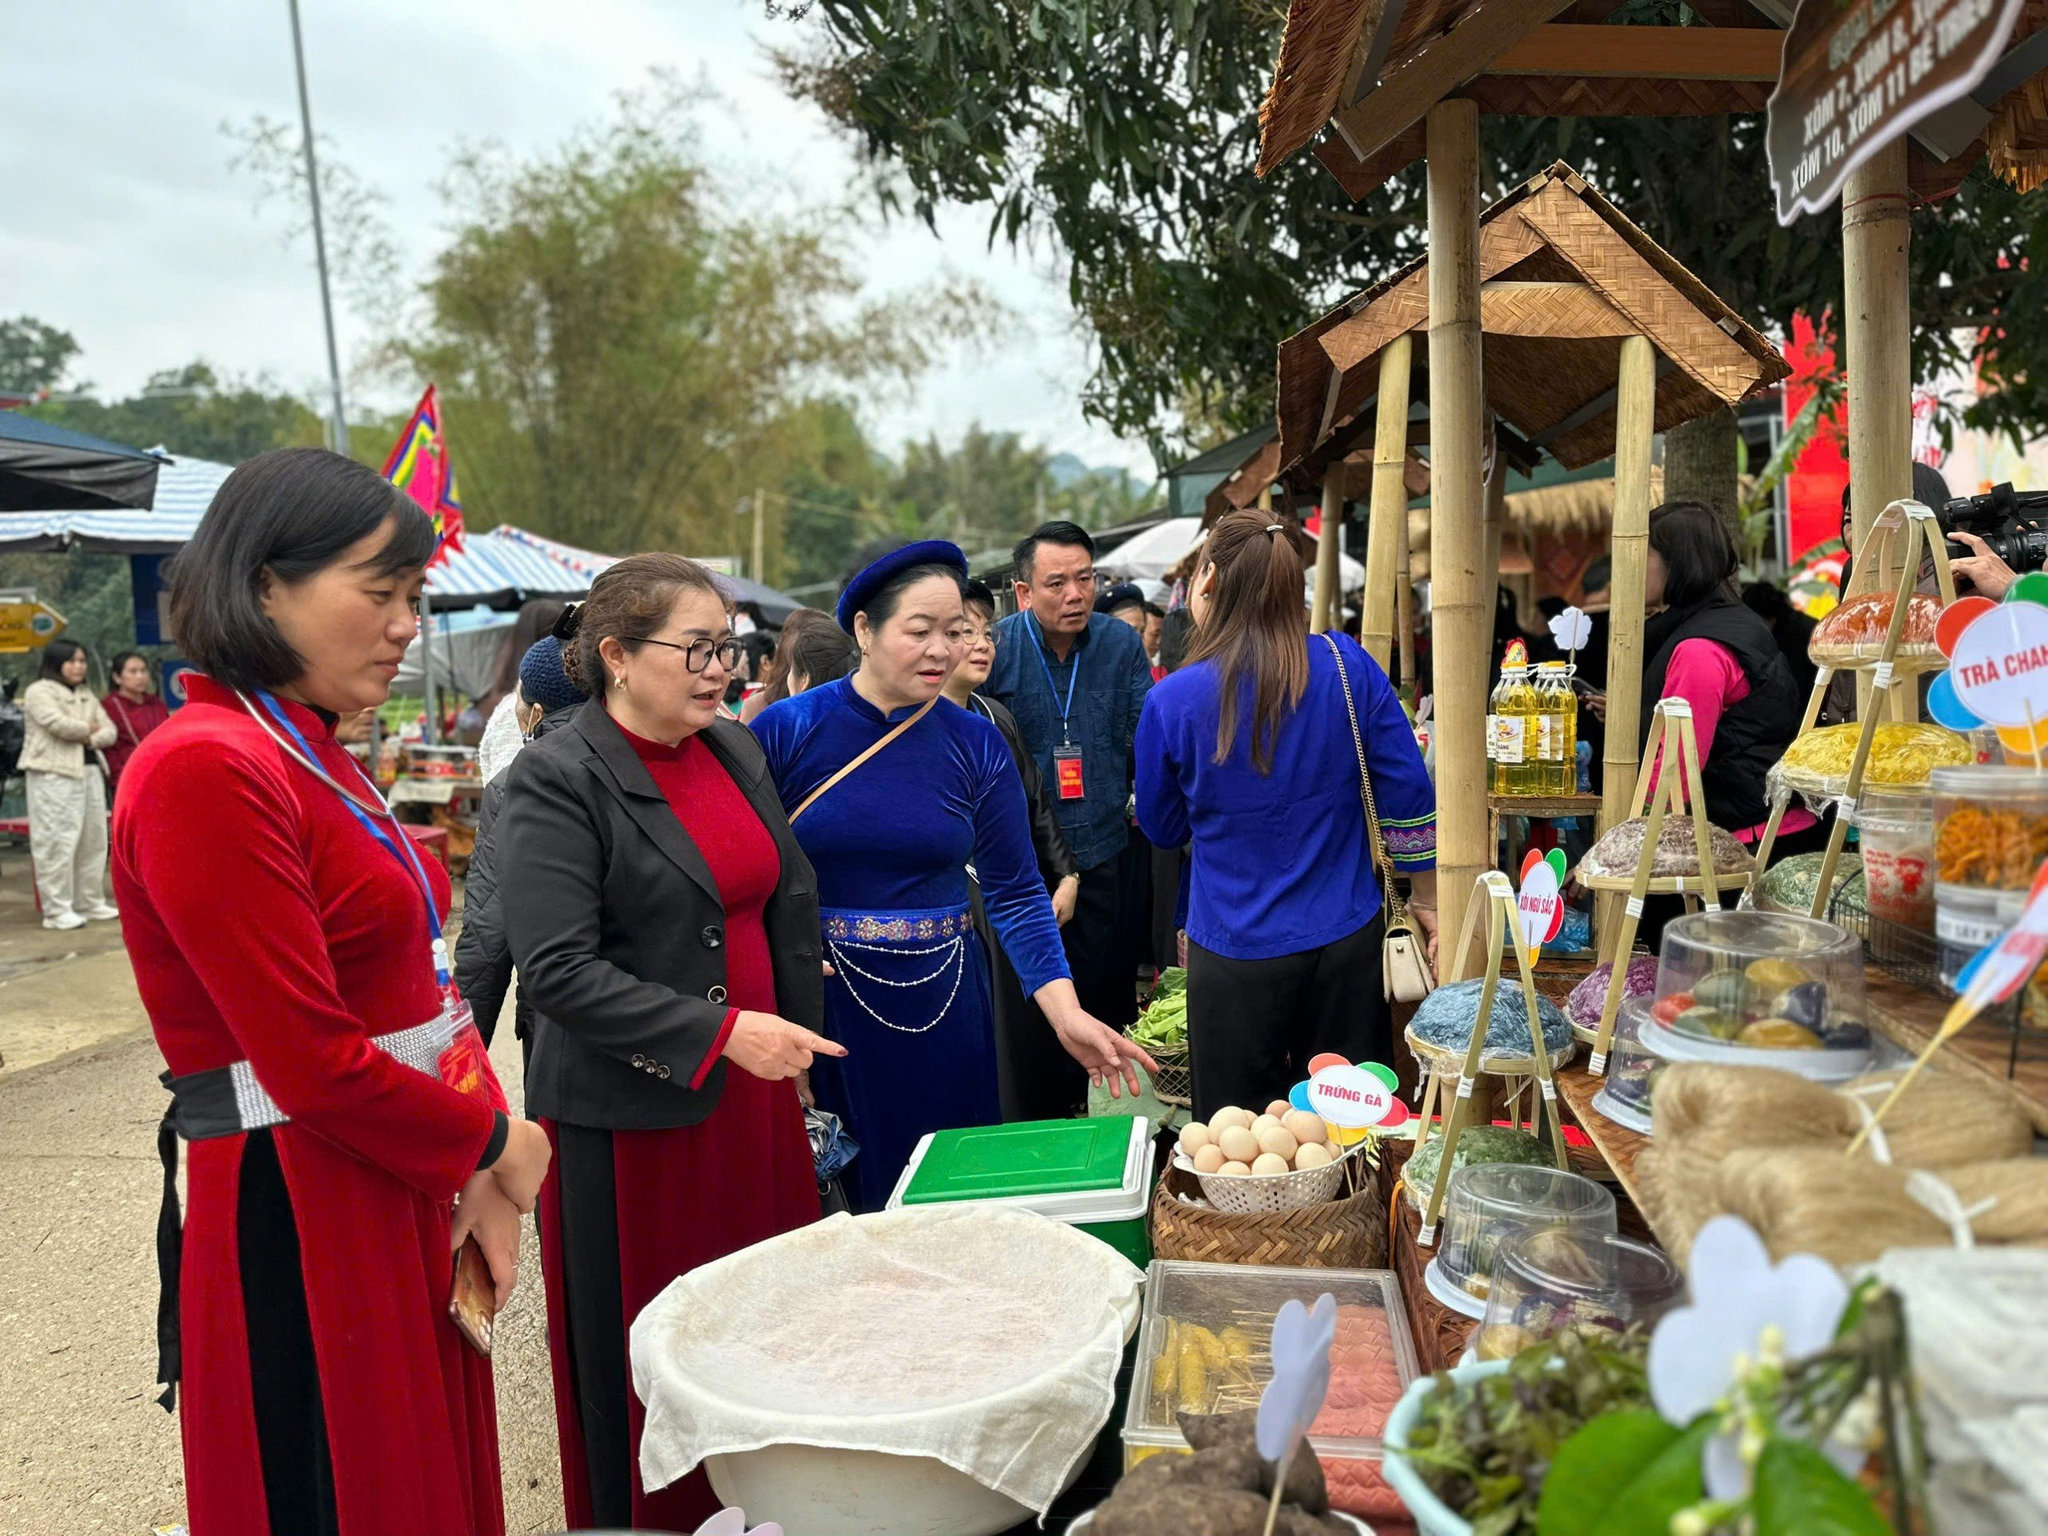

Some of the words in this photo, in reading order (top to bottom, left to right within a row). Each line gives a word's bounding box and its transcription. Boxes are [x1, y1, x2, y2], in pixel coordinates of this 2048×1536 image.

[1791, 152, 1820, 198] XÓM
[1824, 126, 1845, 166] 10,
[1848, 84, 1884, 145] XÓM
[1886, 61, 1905, 107] 11
[1804, 88, 1835, 146] XÓM
[1960, 655, 2000, 689] TRÀ
[1318, 1084, 1361, 1102] TRỨNG
[1364, 1094, 1382, 1108] GÀ
